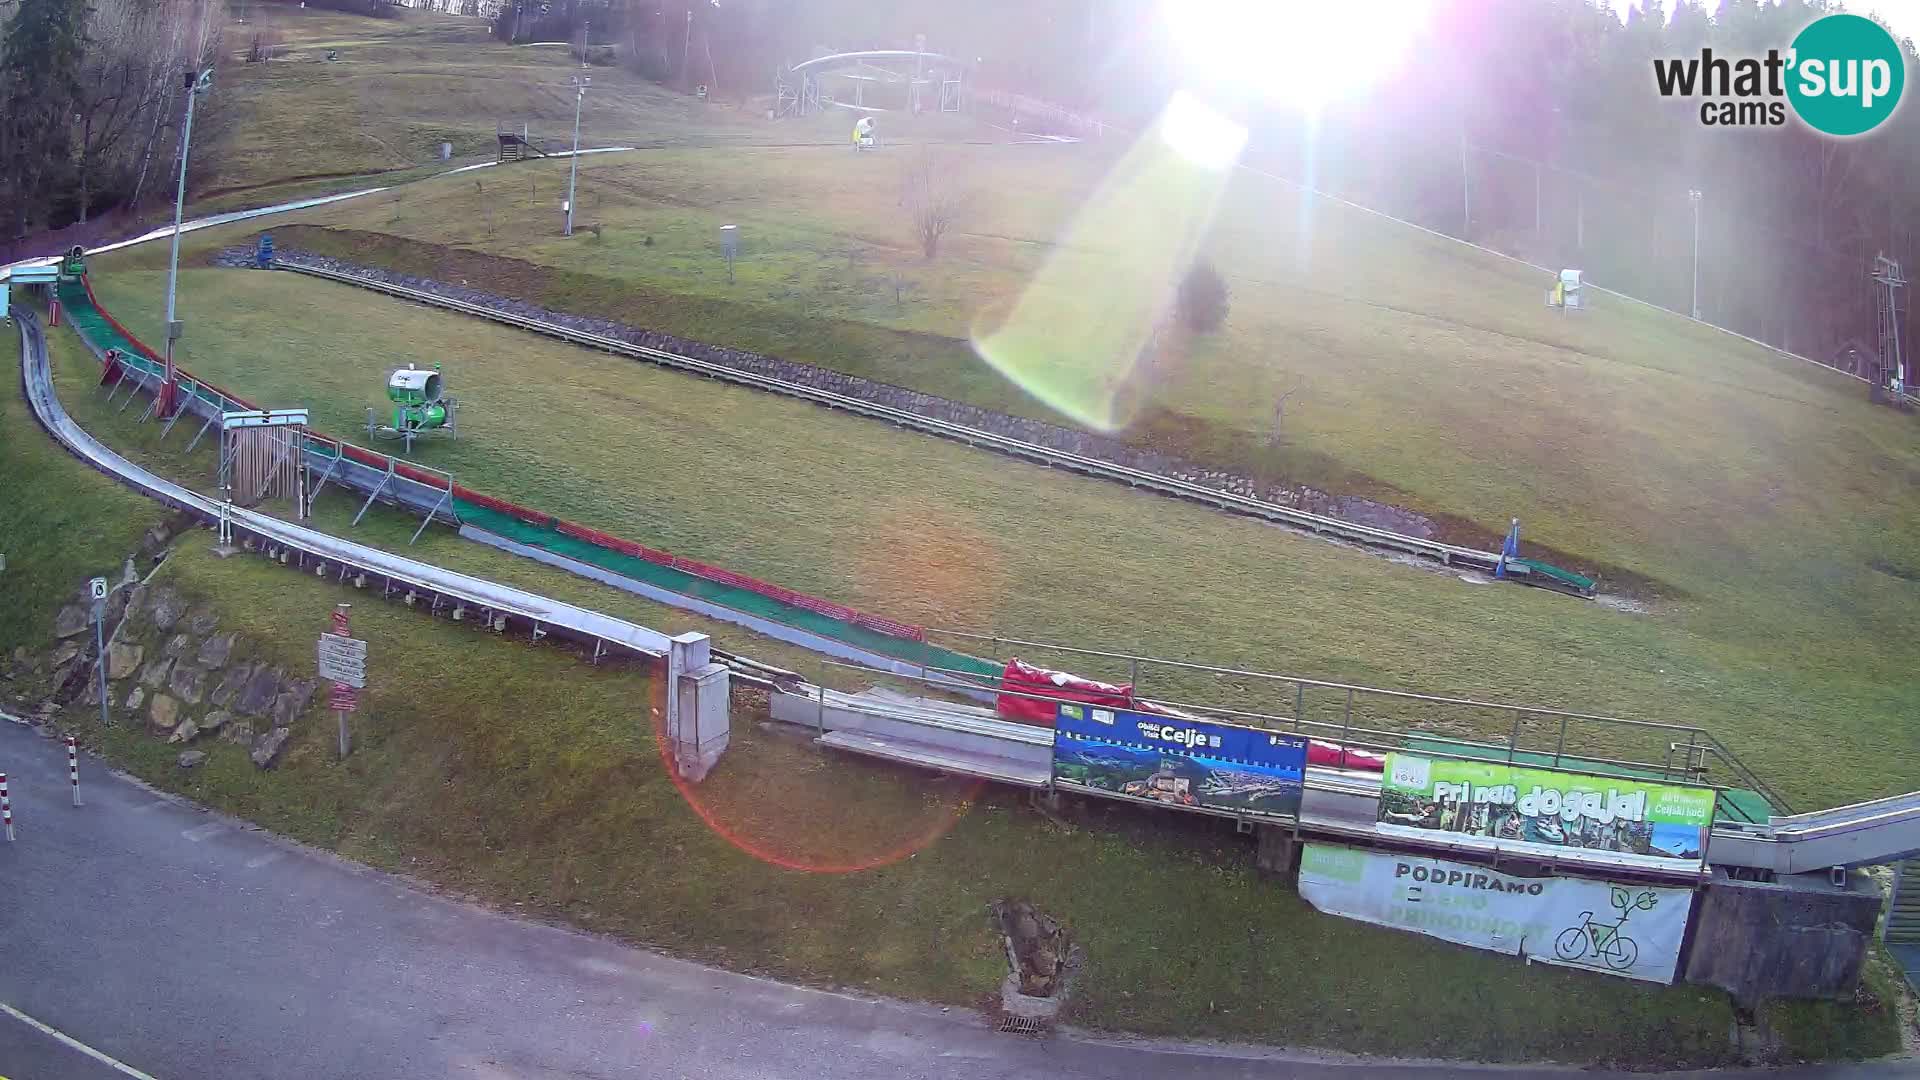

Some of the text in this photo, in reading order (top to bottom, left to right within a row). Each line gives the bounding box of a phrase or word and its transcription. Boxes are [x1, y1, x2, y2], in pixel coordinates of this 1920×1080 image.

[1160, 726, 1207, 748] Celje
[1474, 784, 1517, 805] nas
[1517, 785, 1647, 824] dogaja!
[1394, 862, 1544, 897] PODPIRAMO
